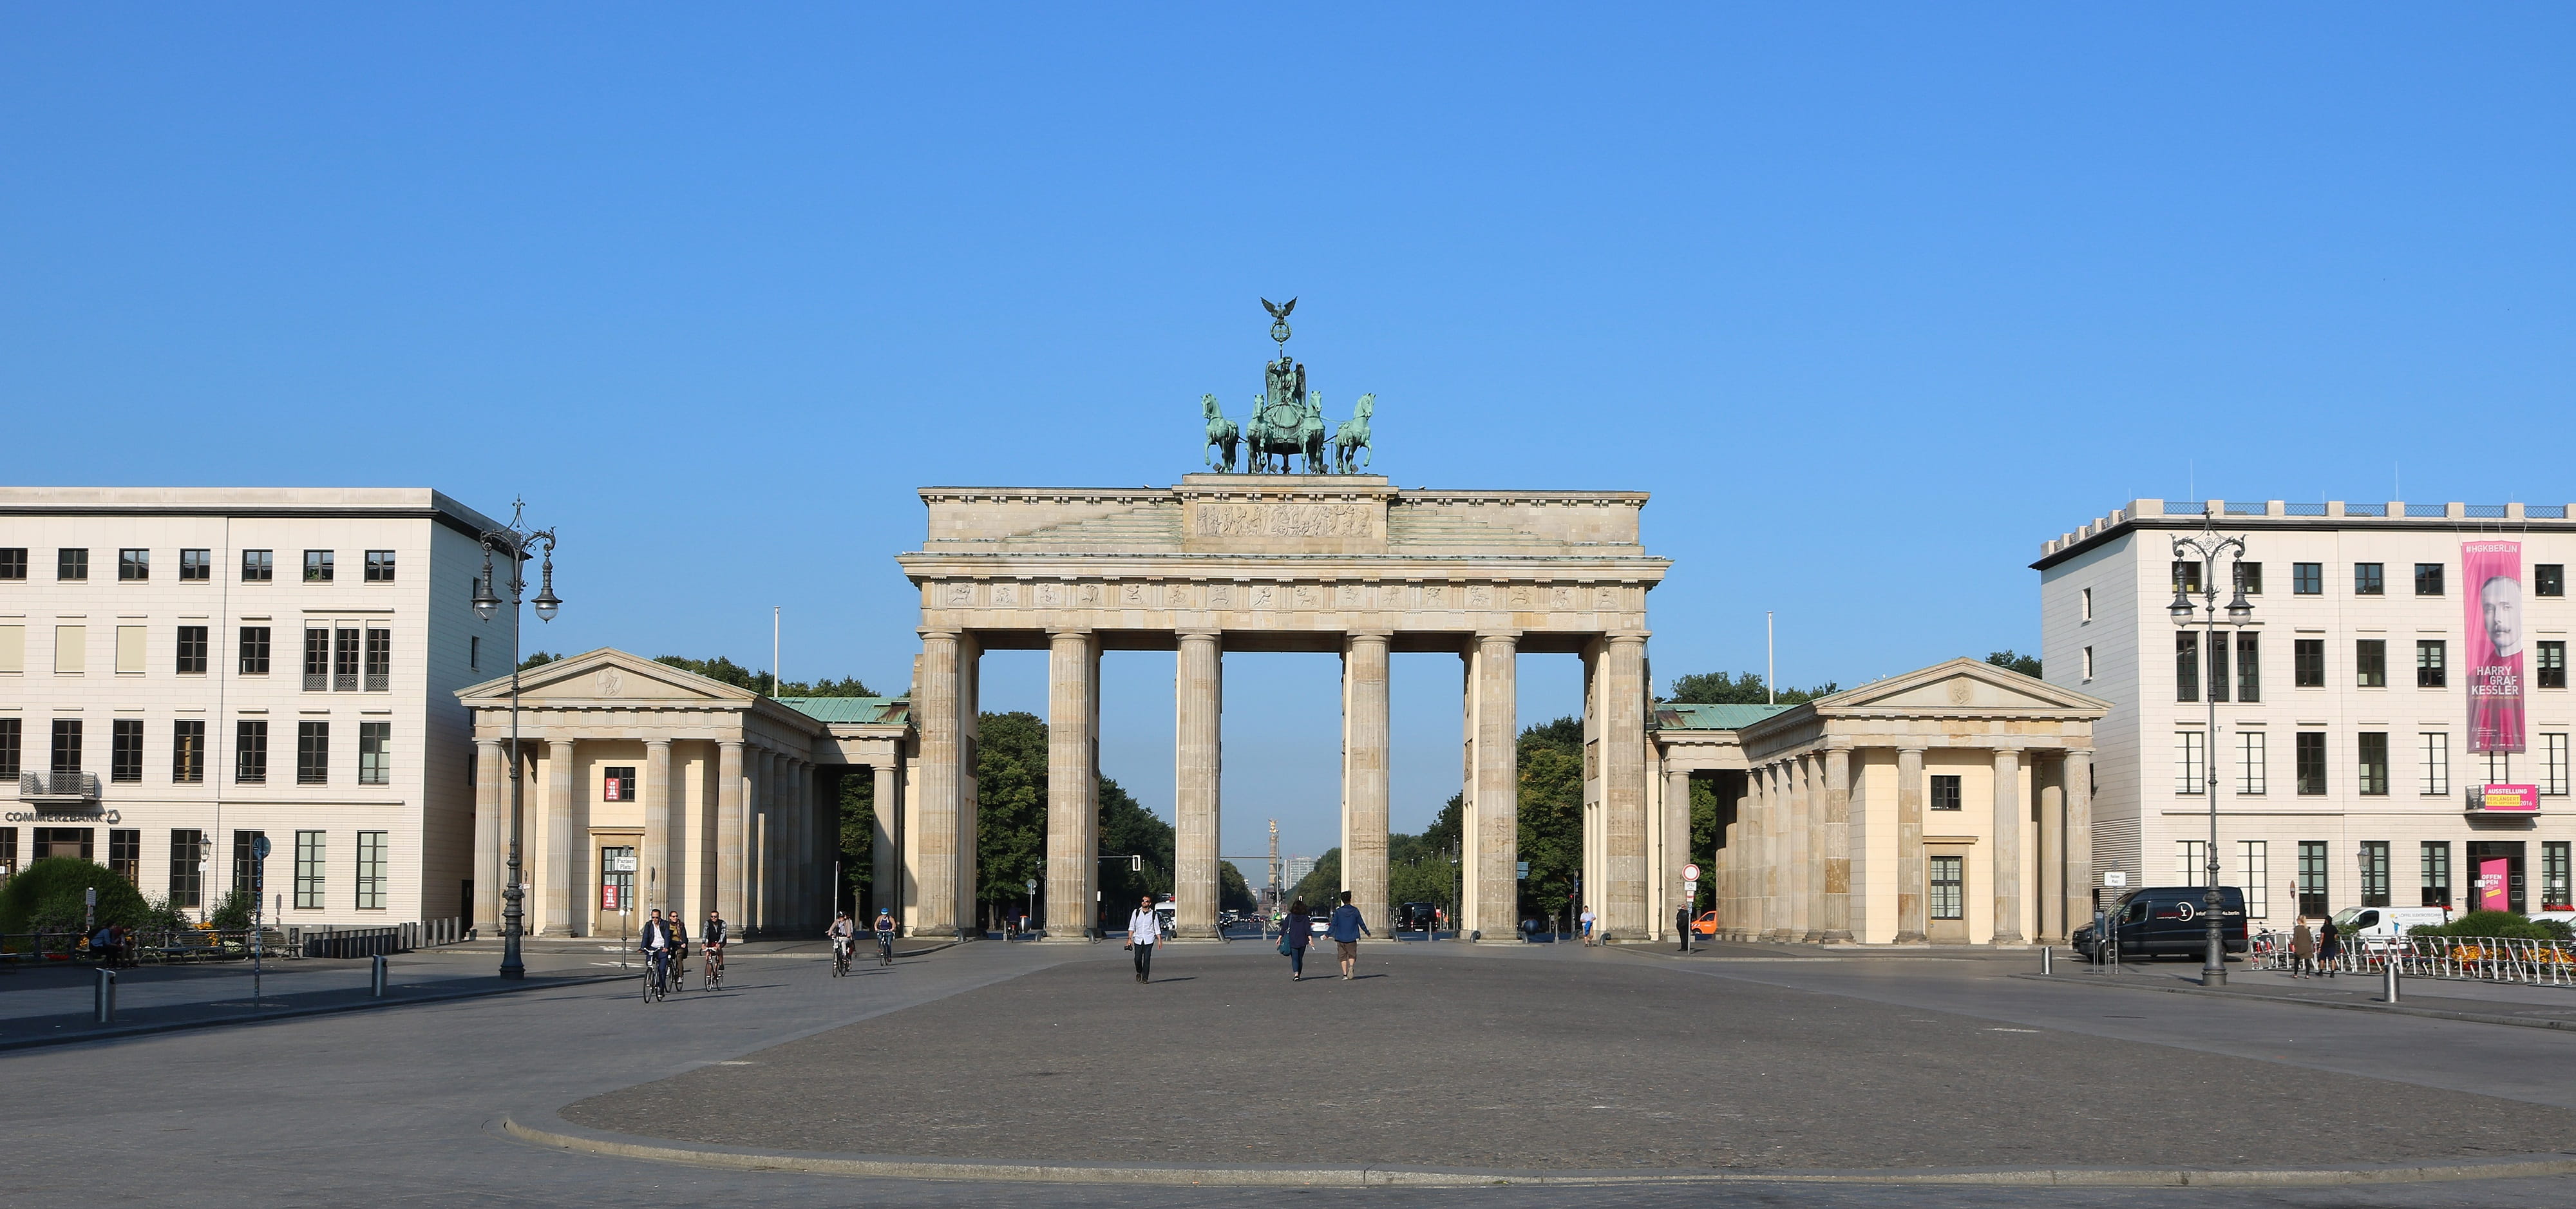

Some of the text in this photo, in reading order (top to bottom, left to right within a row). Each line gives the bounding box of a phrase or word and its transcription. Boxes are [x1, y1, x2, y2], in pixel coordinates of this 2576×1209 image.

[2466, 544, 2517, 553] #HGKBERLIN
[2477, 666, 2512, 676] HARRY
[2490, 676, 2517, 685] GRAF
[2472, 685, 2519, 695] KESSLER
[5, 812, 104, 823] COMMERZBANK
